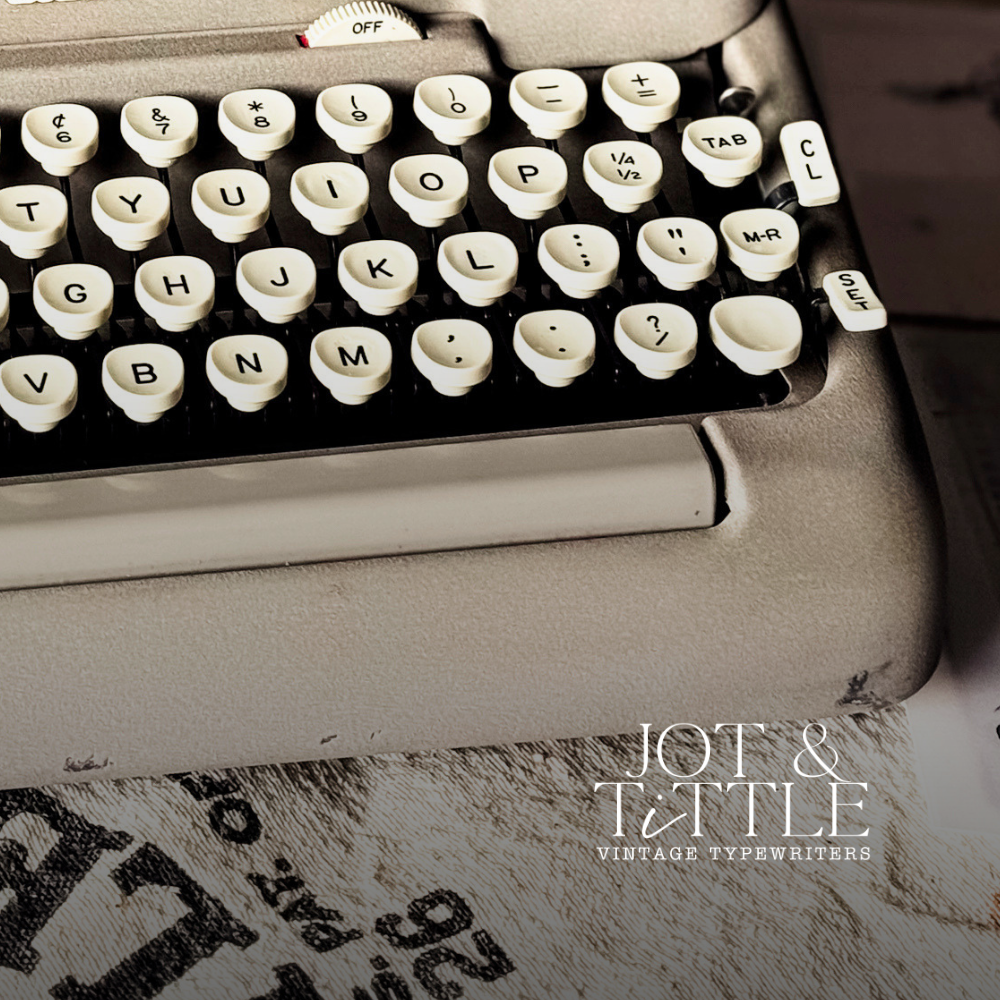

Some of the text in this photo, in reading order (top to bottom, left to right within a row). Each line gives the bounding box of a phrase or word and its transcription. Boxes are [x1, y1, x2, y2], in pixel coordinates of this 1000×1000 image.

[352, 21, 383, 34] OFF
[152, 108, 170, 121] &
[254, 116, 270, 127] 8
[352, 111, 367, 121] 9
[56, 132, 71, 142] 6
[156, 123, 169, 135] 7
[702, 134, 747, 148] TAB
[420, 173, 443, 191] O
[518, 165, 538, 183] P
[220, 187, 245, 206] U
[327, 180, 338, 198] I
[16, 202, 39, 221] T
[119, 194, 141, 213] Y
[367, 259, 393, 279] K
[466, 250, 494, 270] L
[163, 275, 190, 296] H
[271, 267, 289, 286] J
[64, 284, 87, 303] G
[236, 353, 262, 374] N
[338, 346, 369, 366] M
[23, 372, 48, 393] V
[131, 363, 157, 384] B
